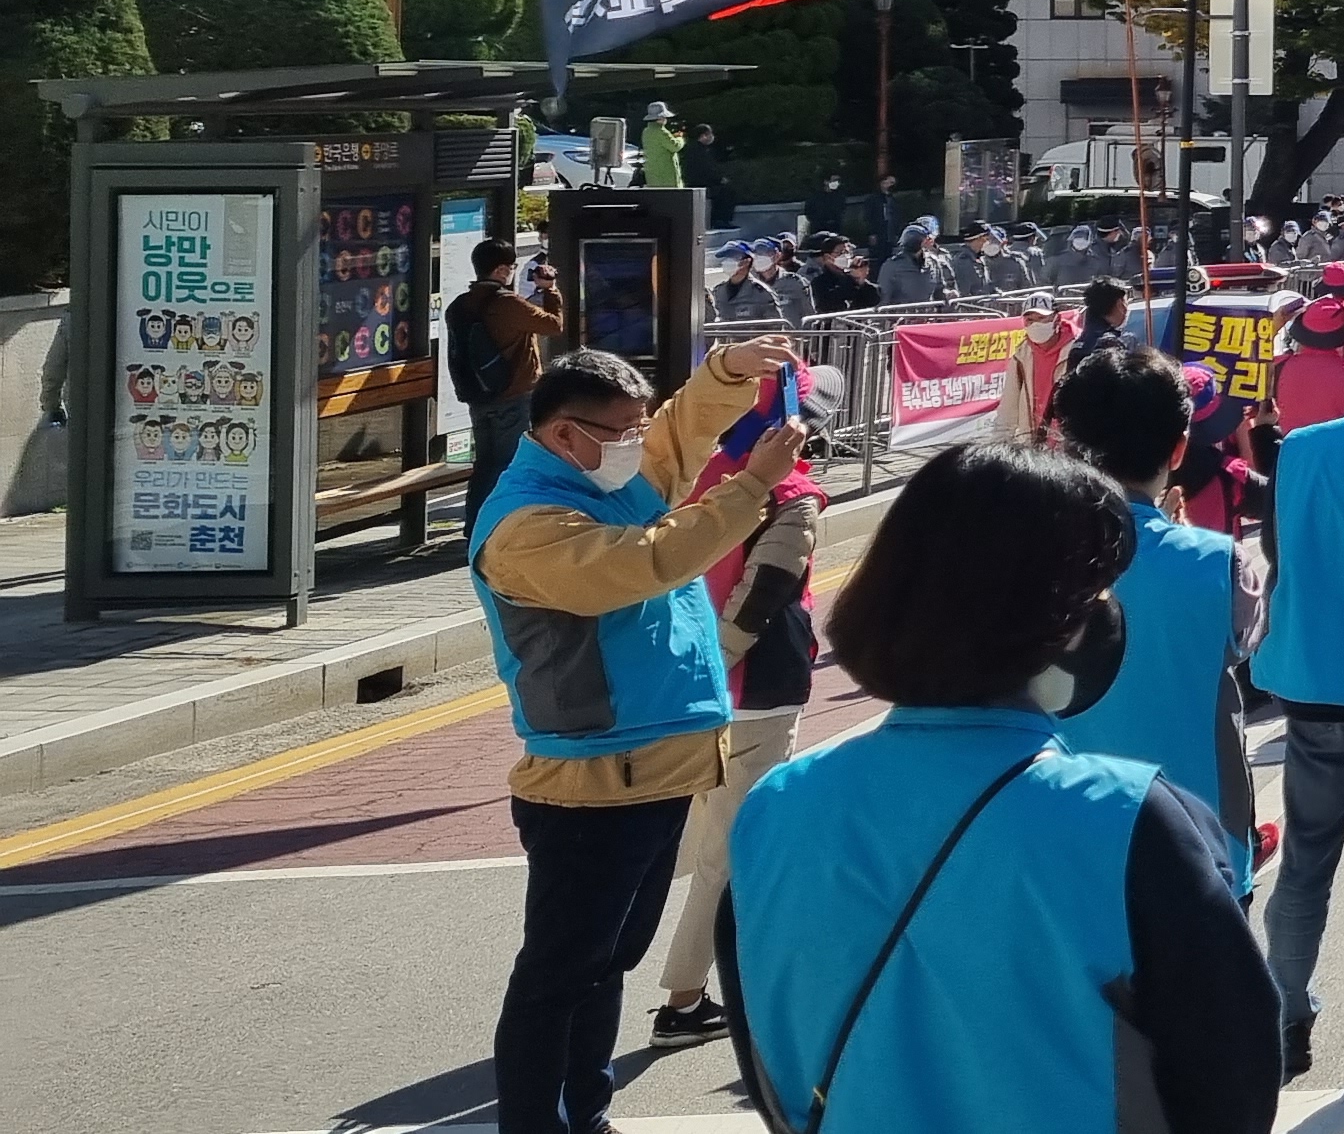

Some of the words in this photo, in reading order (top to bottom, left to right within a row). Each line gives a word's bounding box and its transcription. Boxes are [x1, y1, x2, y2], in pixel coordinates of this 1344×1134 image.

[322, 143, 359, 163] 한국은행
[143, 210, 209, 232] 시민이
[143, 235, 211, 268] 낭만
[142, 270, 255, 303] 이웃으로
[1184, 311, 1274, 360] 총파업
[133, 469, 190, 489] 우리가
[195, 470, 249, 490] 만드는
[132, 492, 247, 521] 문화도시
[189, 525, 245, 553] 춘천
